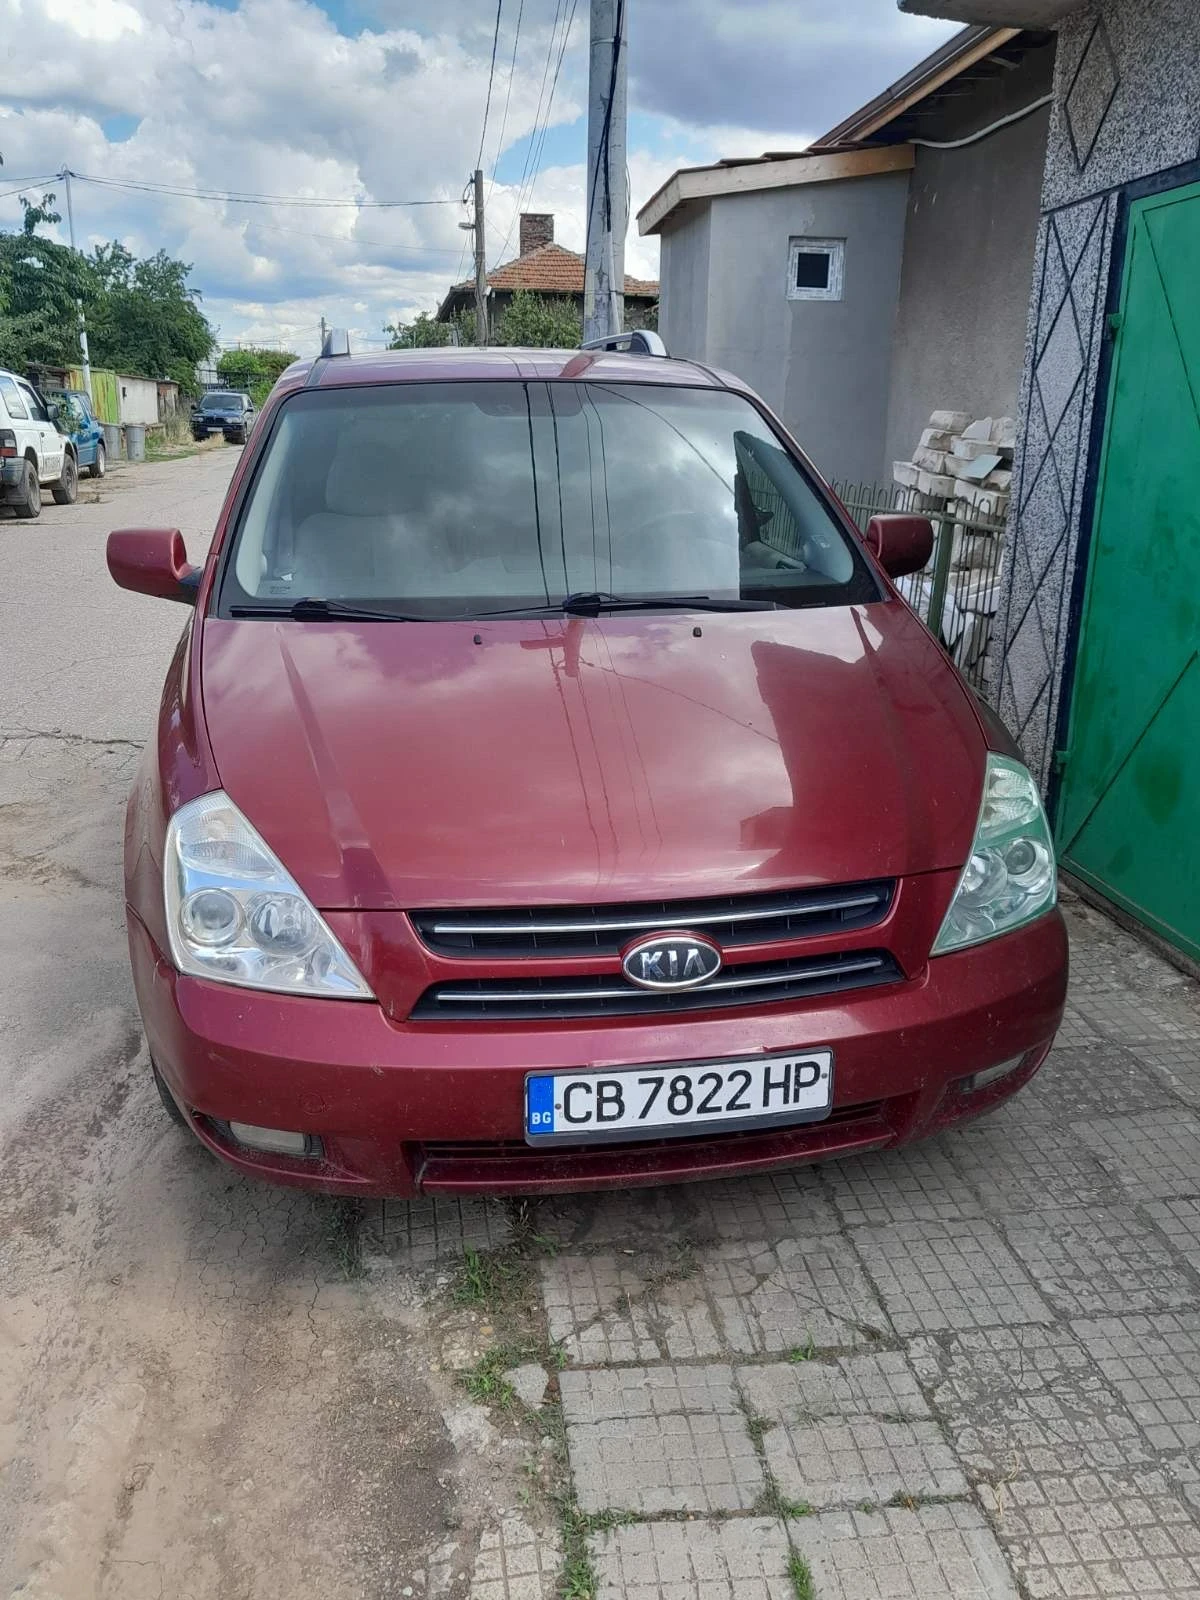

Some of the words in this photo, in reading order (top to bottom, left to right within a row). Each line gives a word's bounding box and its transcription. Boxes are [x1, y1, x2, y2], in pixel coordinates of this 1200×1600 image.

[640, 948, 707, 979] KIA
[563, 1080, 625, 1123] CB
[638, 1070, 752, 1119] 7822
[762, 1061, 821, 1107] HP
[531, 1111, 552, 1125] BG
